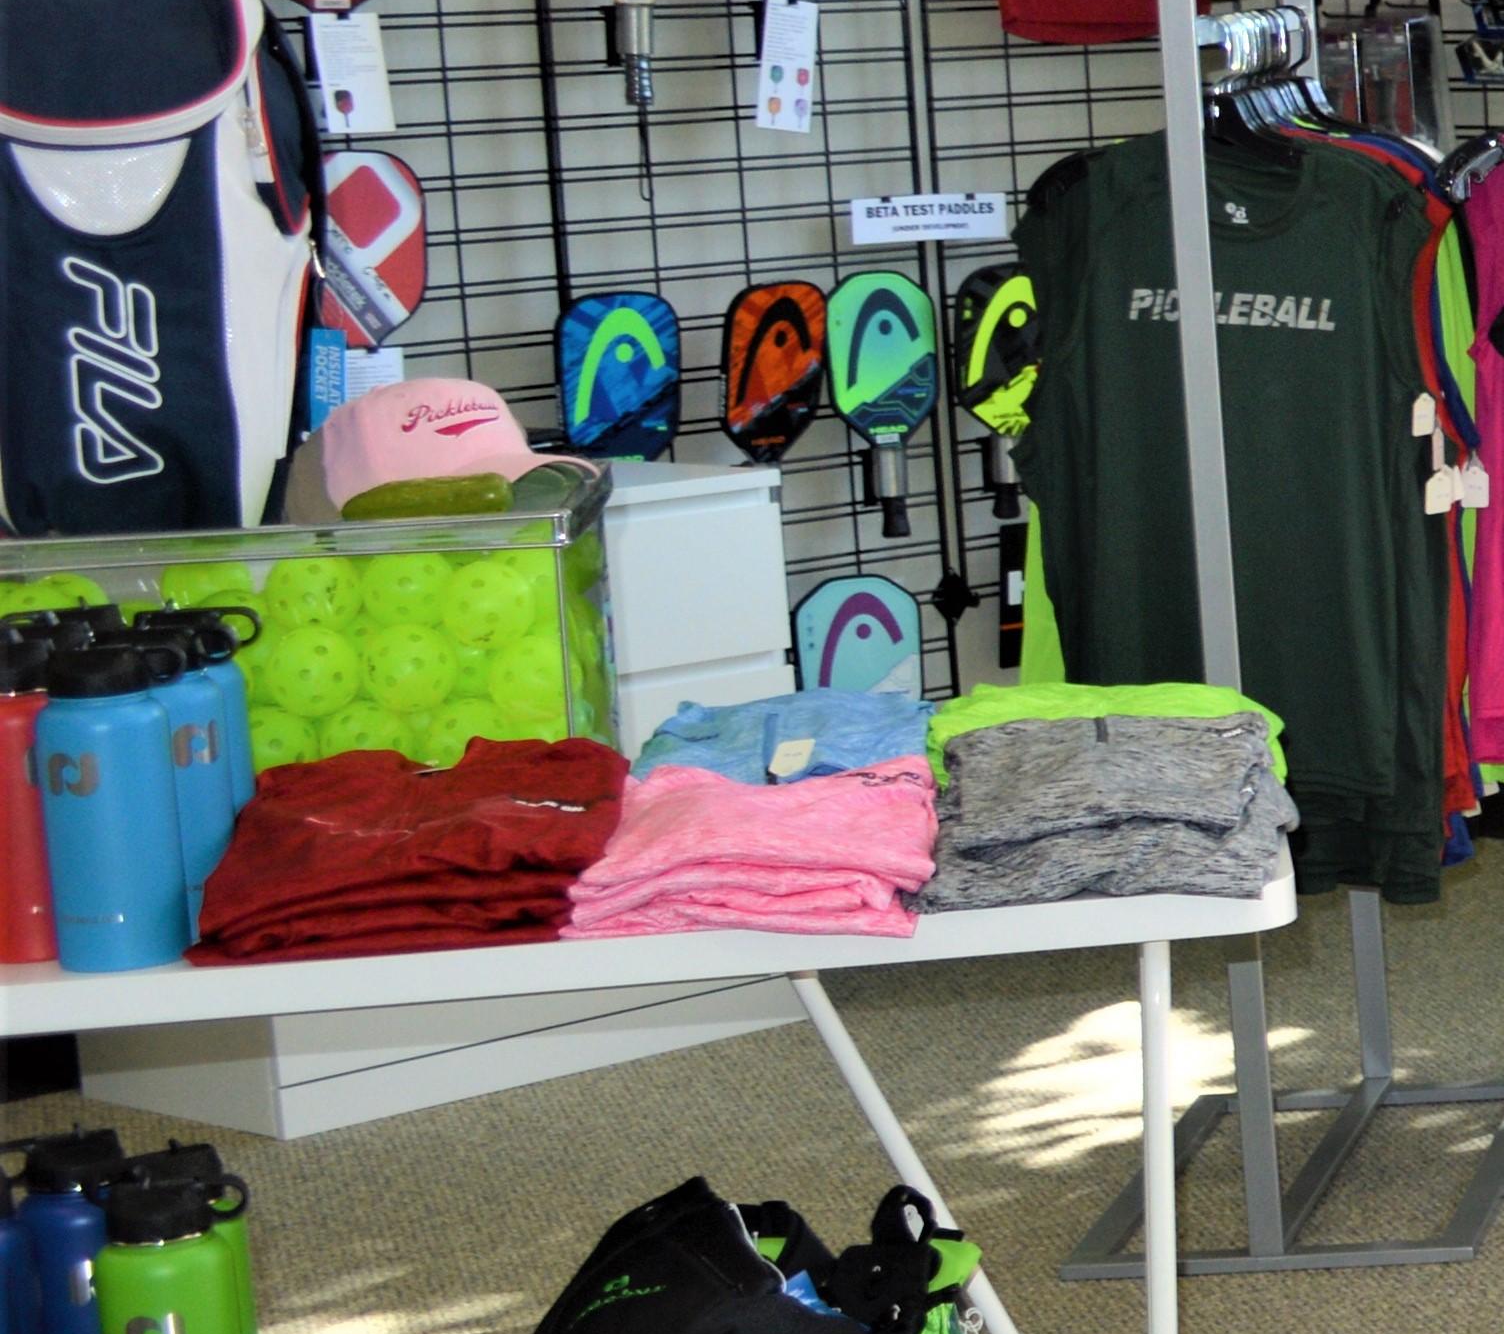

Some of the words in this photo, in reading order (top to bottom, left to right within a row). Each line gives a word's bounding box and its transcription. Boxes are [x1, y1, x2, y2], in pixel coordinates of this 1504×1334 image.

[866, 205, 899, 218] BETA
[903, 203, 934, 216] TEST
[938, 202, 995, 215] PADDLES
[1129, 288, 1336, 331] PICLEBALL
[65, 257, 164, 485] FILA
[315, 346, 328, 402] POCKET
